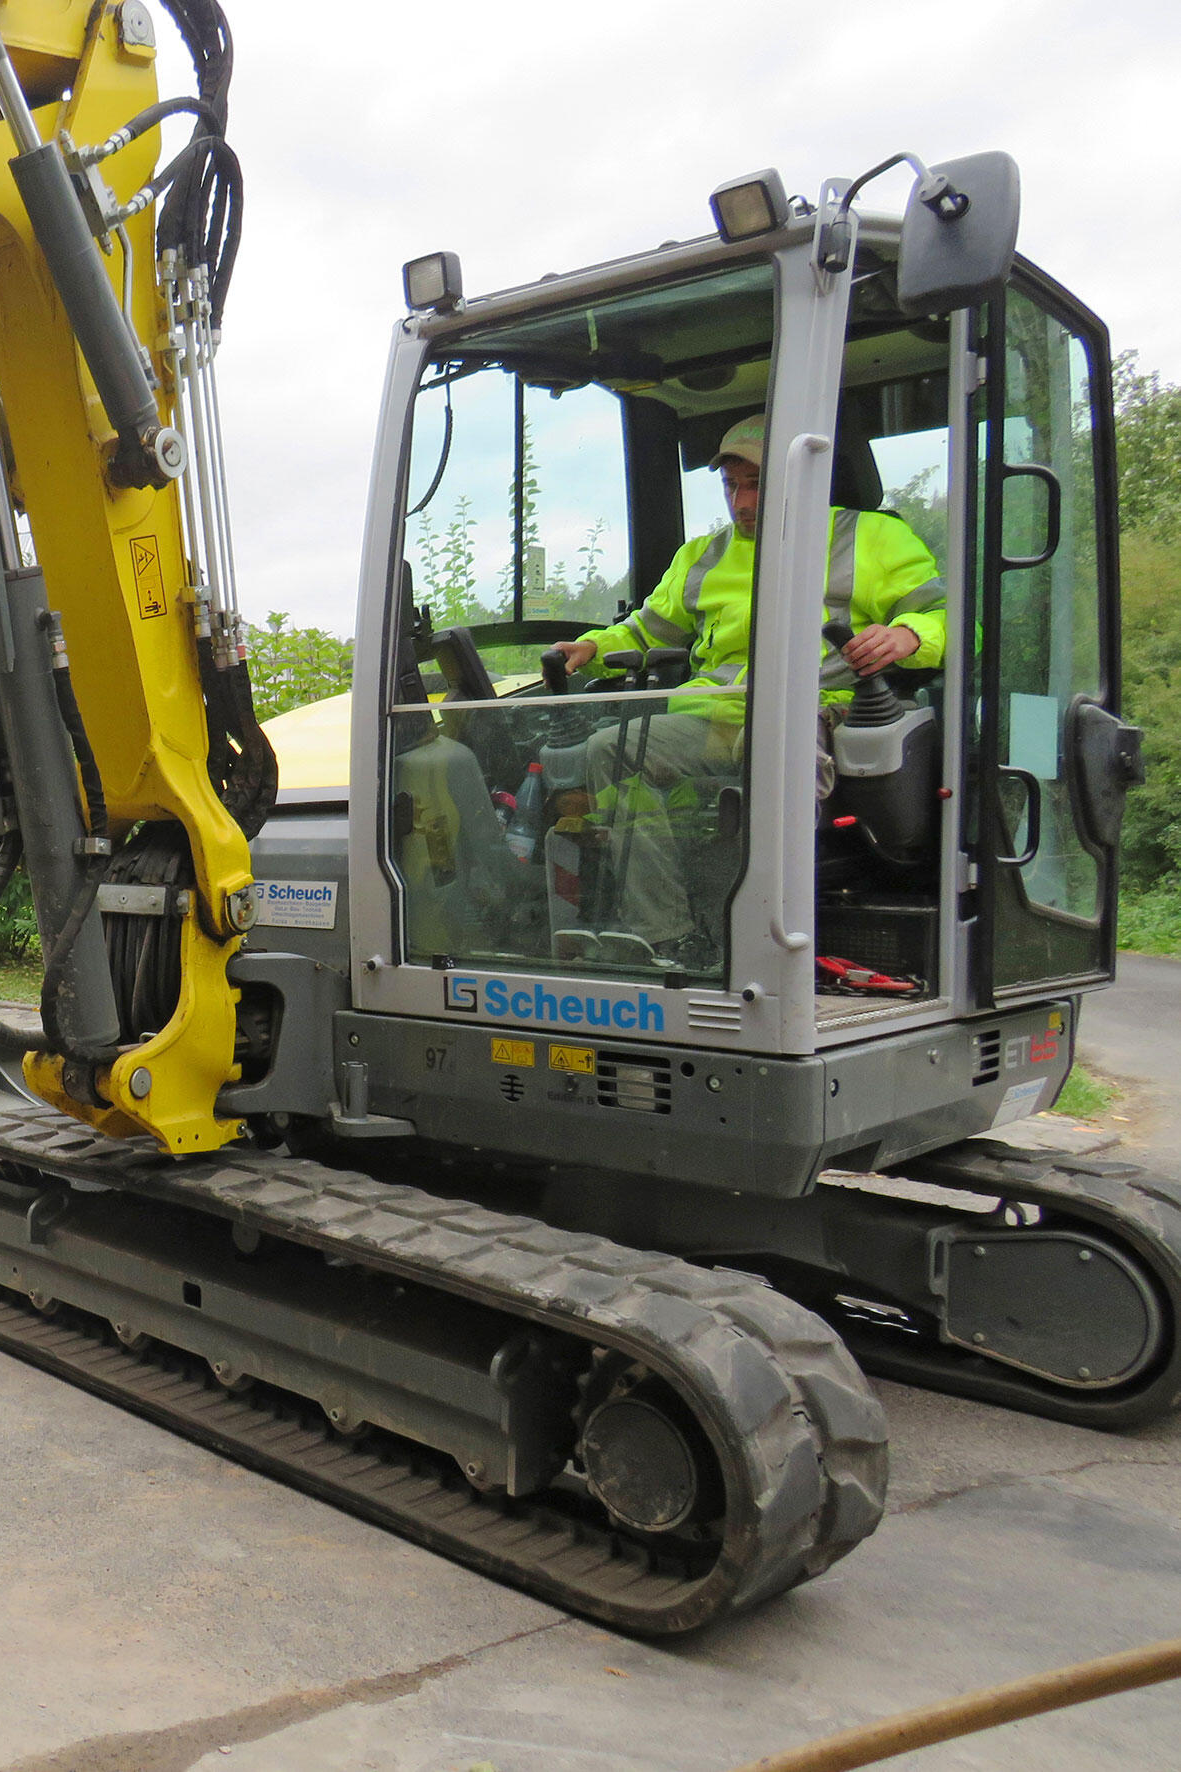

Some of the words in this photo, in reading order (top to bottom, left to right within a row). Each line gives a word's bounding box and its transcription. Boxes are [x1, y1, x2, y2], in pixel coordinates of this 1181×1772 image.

[268, 884, 332, 901] Scheuch
[484, 979, 665, 1032] Scheuch
[425, 1047, 447, 1070] 97
